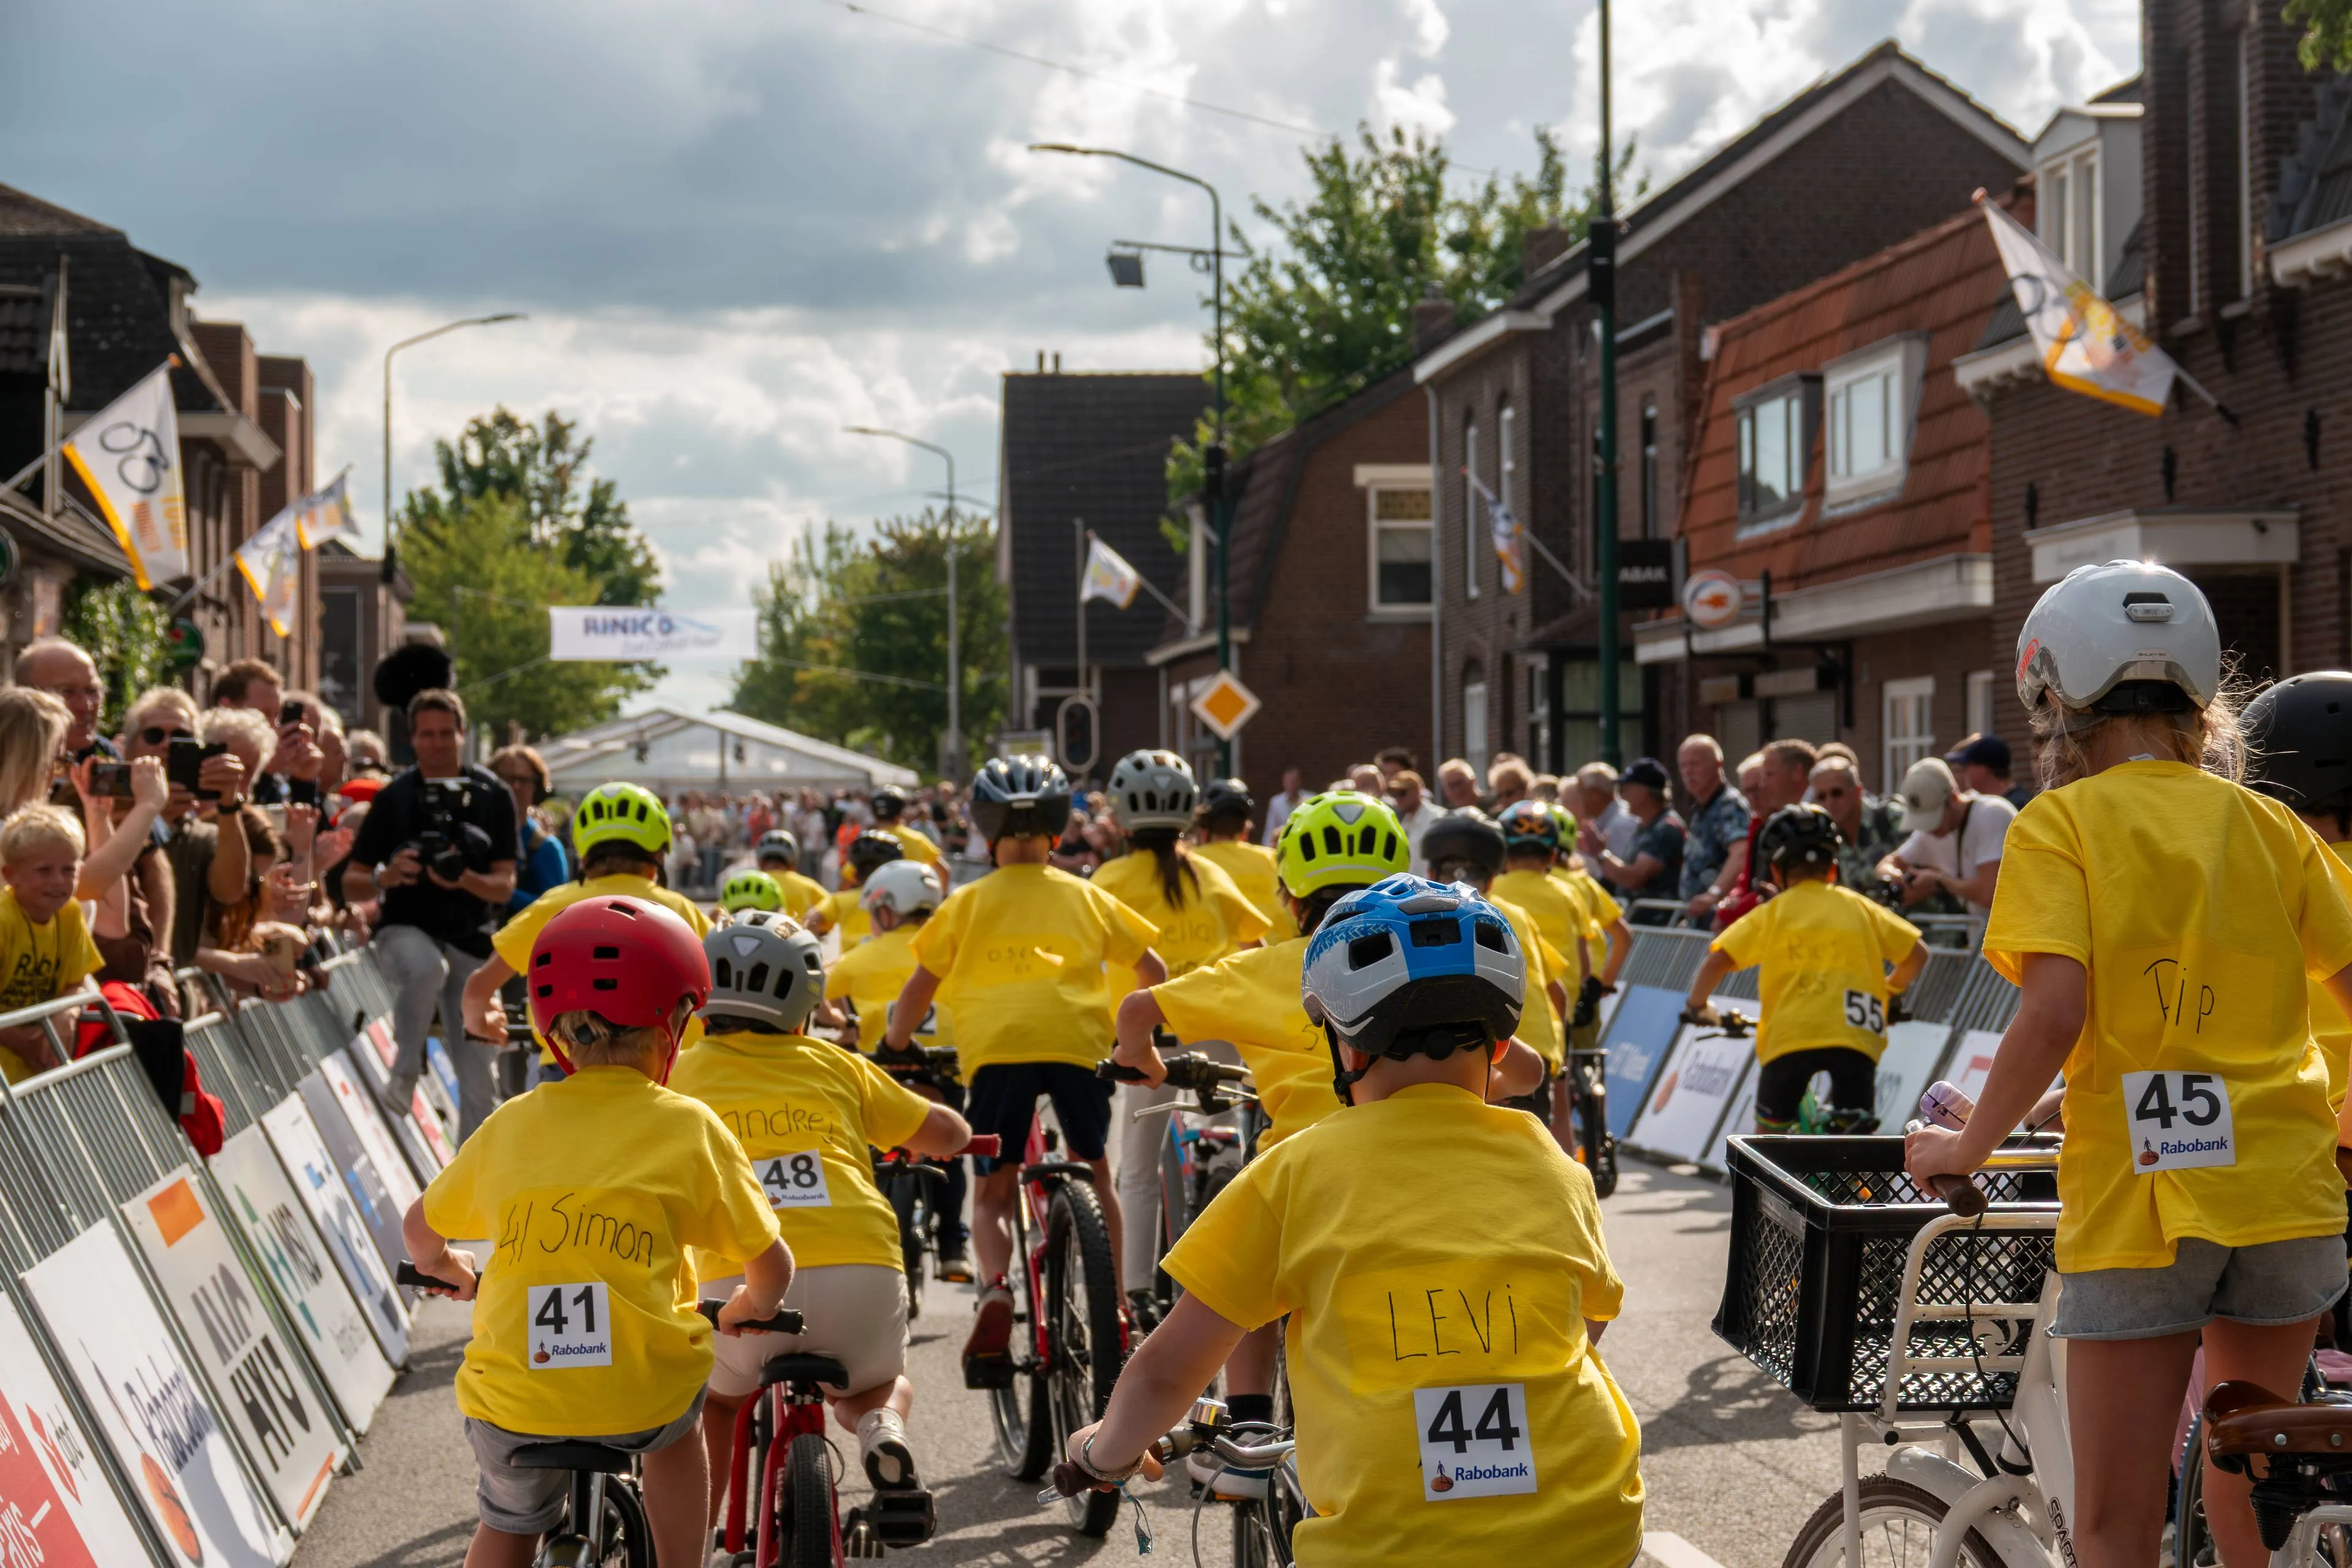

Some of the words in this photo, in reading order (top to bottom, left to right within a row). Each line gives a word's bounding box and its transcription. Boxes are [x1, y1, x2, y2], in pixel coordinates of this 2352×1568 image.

[1846, 989, 1884, 1035] 55
[2135, 1074, 2221, 1129] 45
[2160, 1136, 2228, 1155] Rabobank
[763, 1154, 818, 1189] 48
[782, 1192, 826, 1200] Rabobank
[540, 1193, 653, 1268] Simon
[535, 1285, 595, 1335] 41
[552, 1342, 606, 1355] Rabobank
[123, 1338, 213, 1480] Rabobank
[1427, 1387, 1520, 1454] 44
[1455, 1463, 1528, 1482] Rabobank
[0, 1499, 45, 1568] aris
